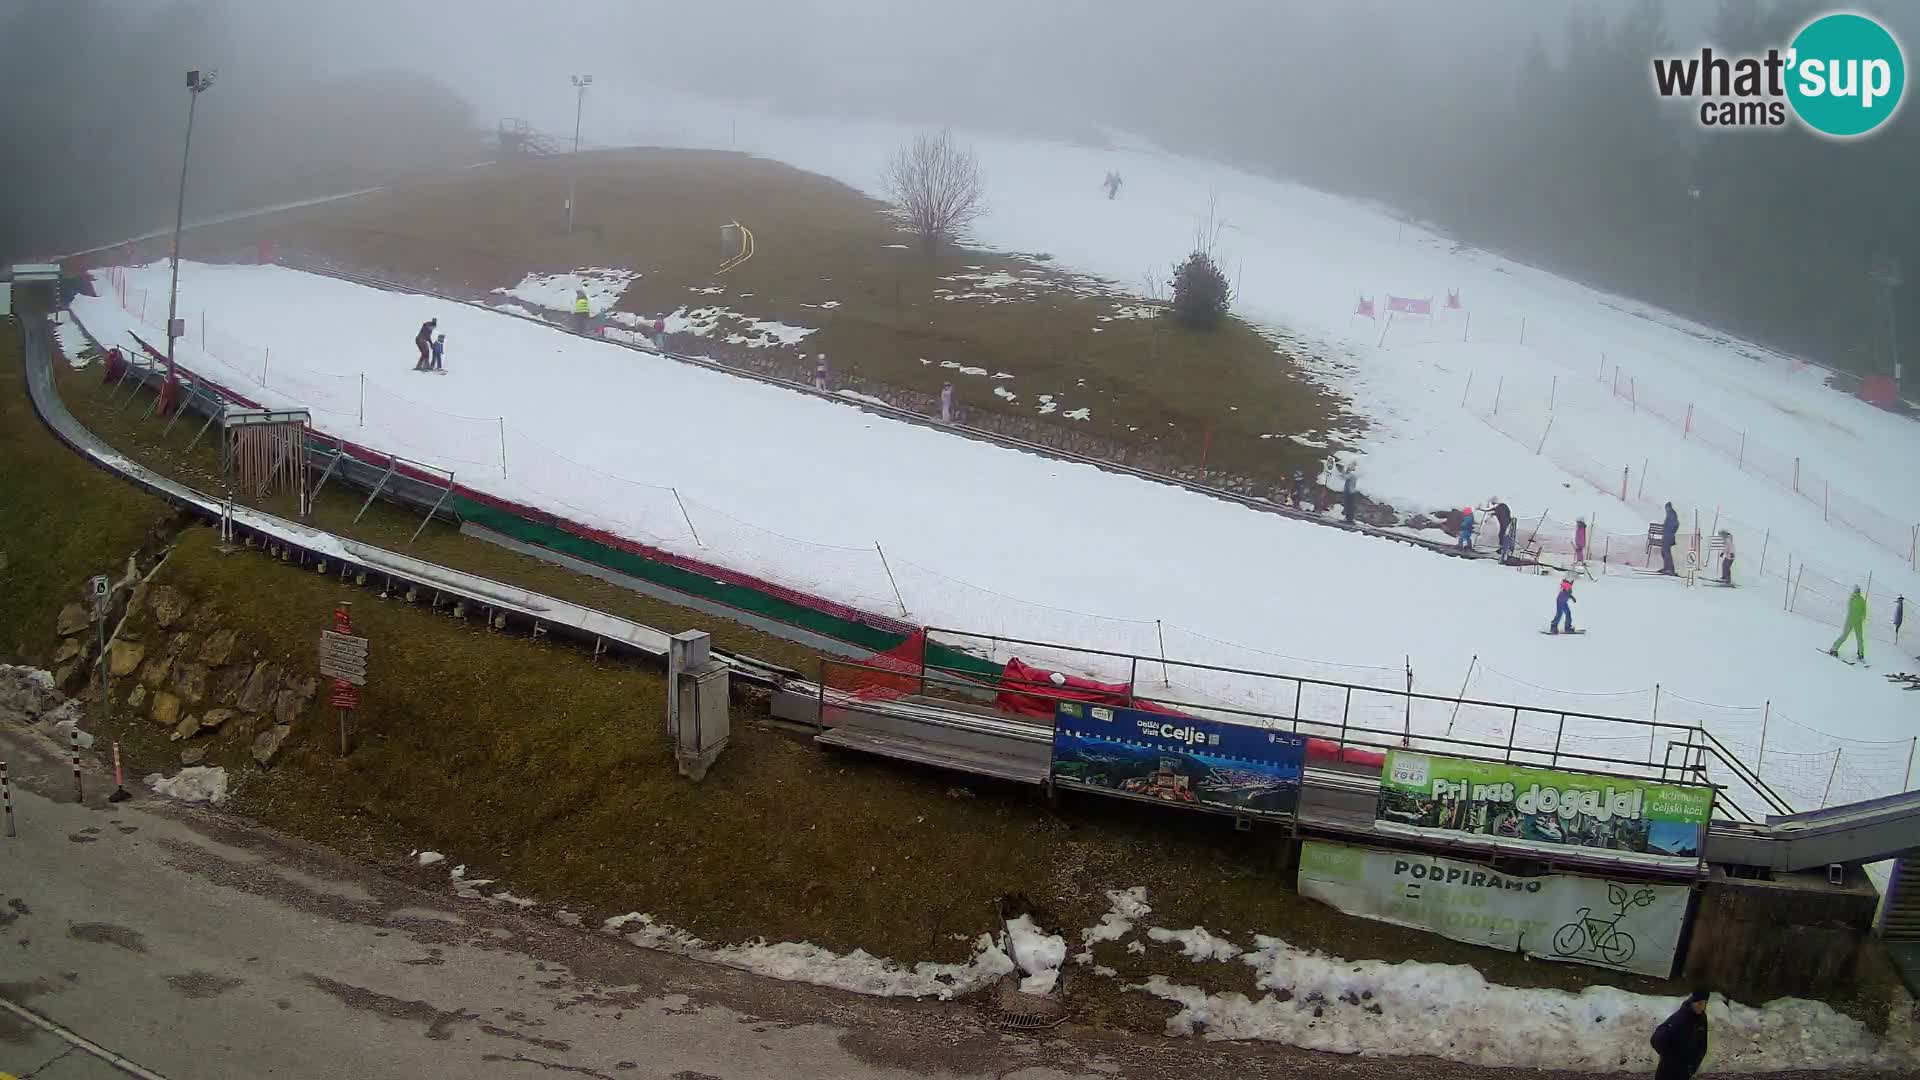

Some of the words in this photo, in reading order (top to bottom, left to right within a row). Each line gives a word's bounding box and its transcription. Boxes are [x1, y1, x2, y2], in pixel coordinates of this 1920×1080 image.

[1160, 723, 1205, 745] Celje
[1473, 782, 1514, 803] nas
[1516, 784, 1644, 821] dogaja!
[1394, 859, 1542, 893] PODPIRAMO
